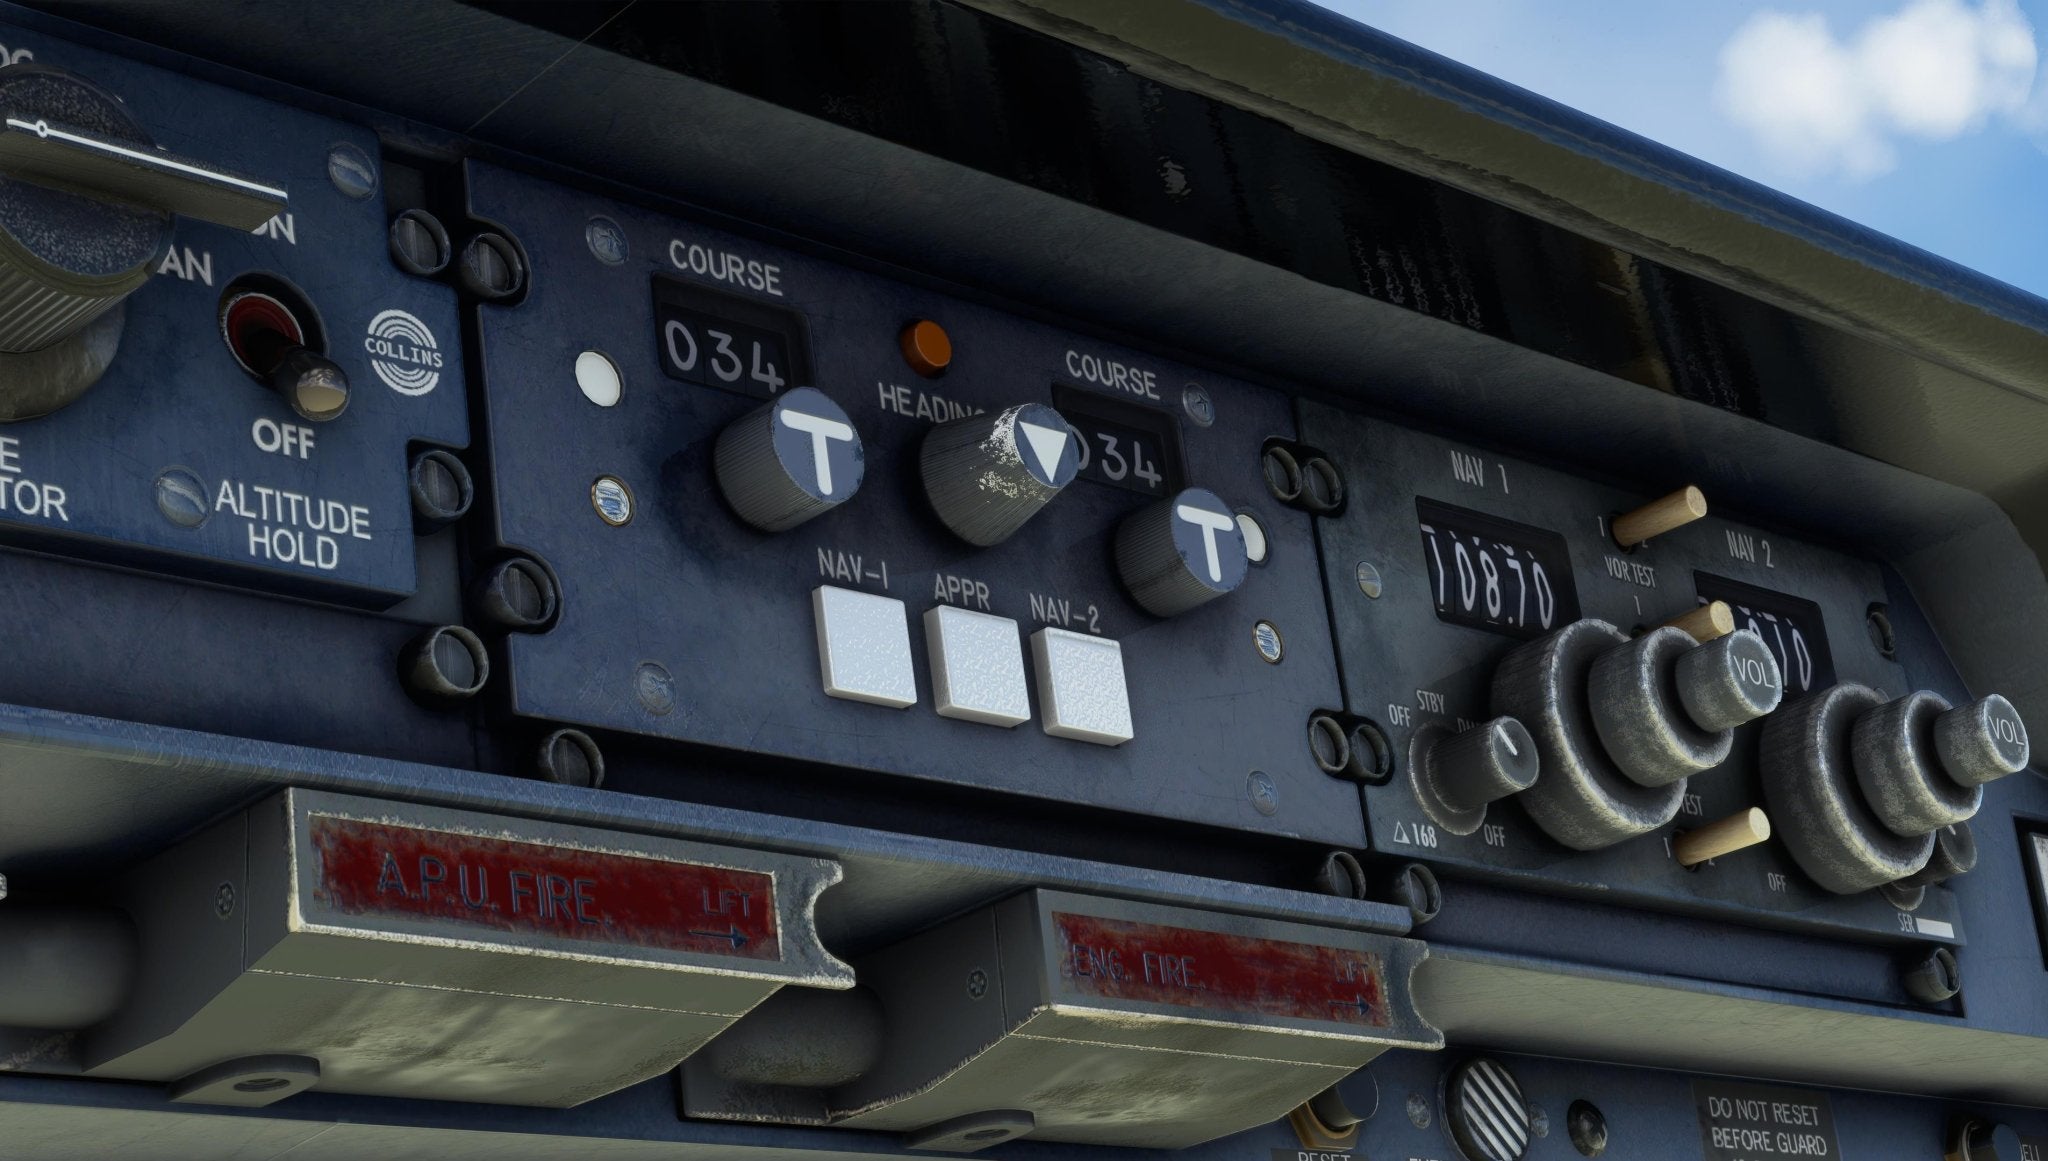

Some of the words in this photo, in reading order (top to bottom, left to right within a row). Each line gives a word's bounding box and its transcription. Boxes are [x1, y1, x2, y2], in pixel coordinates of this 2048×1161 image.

[251, 213, 296, 245] N
[157, 244, 212, 286] AN
[669, 239, 783, 297] COURSE
[365, 336, 442, 368] COLLINS
[664, 319, 785, 394] 034
[1065, 349, 1161, 400] COURSE
[878, 382, 984, 424] HEADIN
[251, 418, 314, 460] OFF
[1450, 449, 1484, 488] NAV
[1498, 464, 1509, 494] 1
[215, 480, 371, 540] ALTITUDE
[249, 523, 338, 570] HOLD
[1725, 530, 1756, 563] NAV
[1761, 541, 1775, 569] 2
[817, 547, 888, 590] NAV-1
[1603, 555, 1631, 582] VOR
[1630, 562, 1656, 588] TEST
[934, 573, 990, 611] APPR
[1030, 593, 1100, 633] NAV-2
[1733, 655, 1775, 689] VOL
[1388, 703, 1410, 728] OFF
[1416, 689, 1445, 715] STBY
[1989, 716, 2025, 747] VOL
[1411, 822, 1437, 849] 168
[1483, 823, 1505, 848] OFF
[1767, 872, 1787, 893] OFF
[702, 886, 753, 920] LIFT
[1897, 912, 1916, 934] SER
[1708, 1096, 1732, 1118] DO
[1735, 1099, 1767, 1121] NOT
[1772, 1103, 1818, 1126] RESET
[1712, 1127, 1774, 1152] BEFORE
[1776, 1132, 1827, 1156] GUARD
